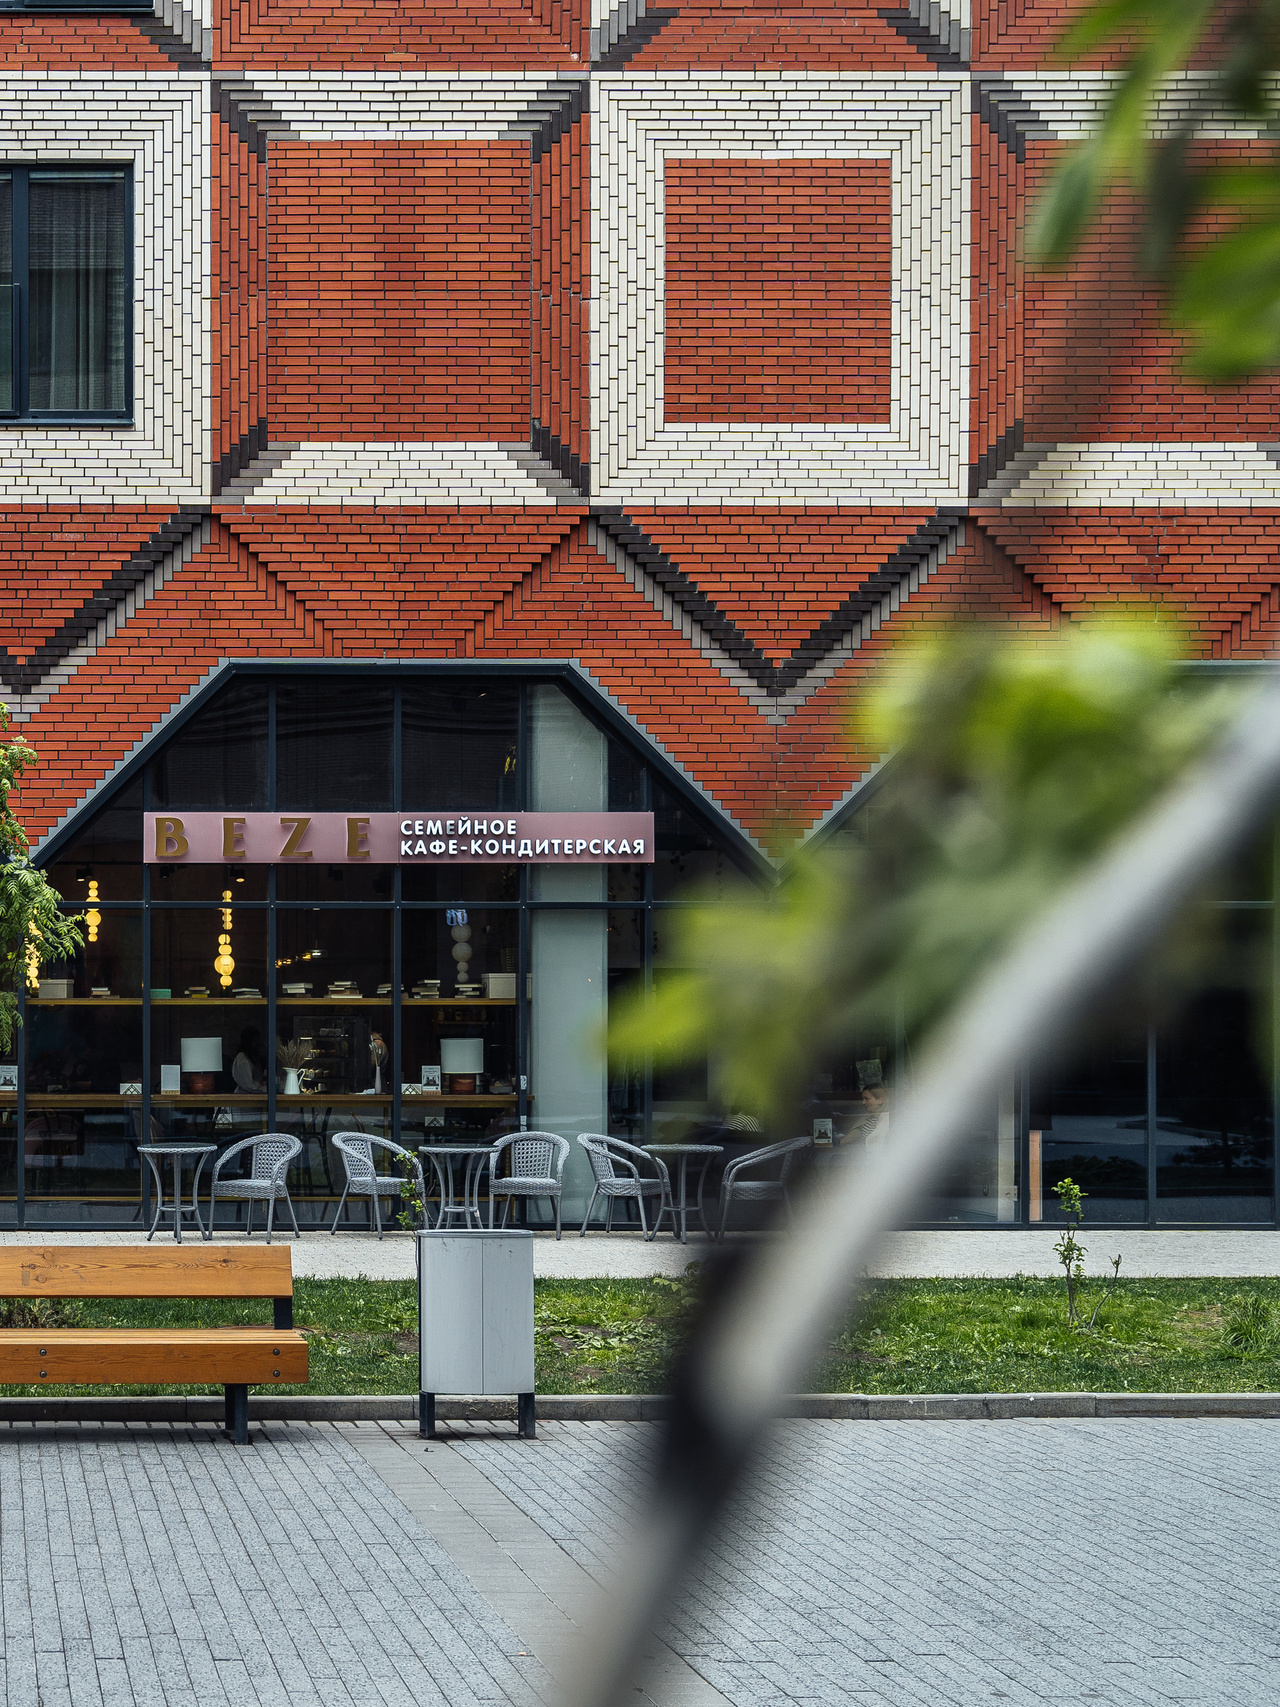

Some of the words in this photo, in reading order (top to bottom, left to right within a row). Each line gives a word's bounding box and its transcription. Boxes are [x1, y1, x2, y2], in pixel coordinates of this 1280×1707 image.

[400, 816, 517, 836] СЕМЕЙНОЕ
[155, 817, 370, 857] BEZE
[400, 839, 645, 858] КАФЕ-КОНДИТЕРСКАЯ
